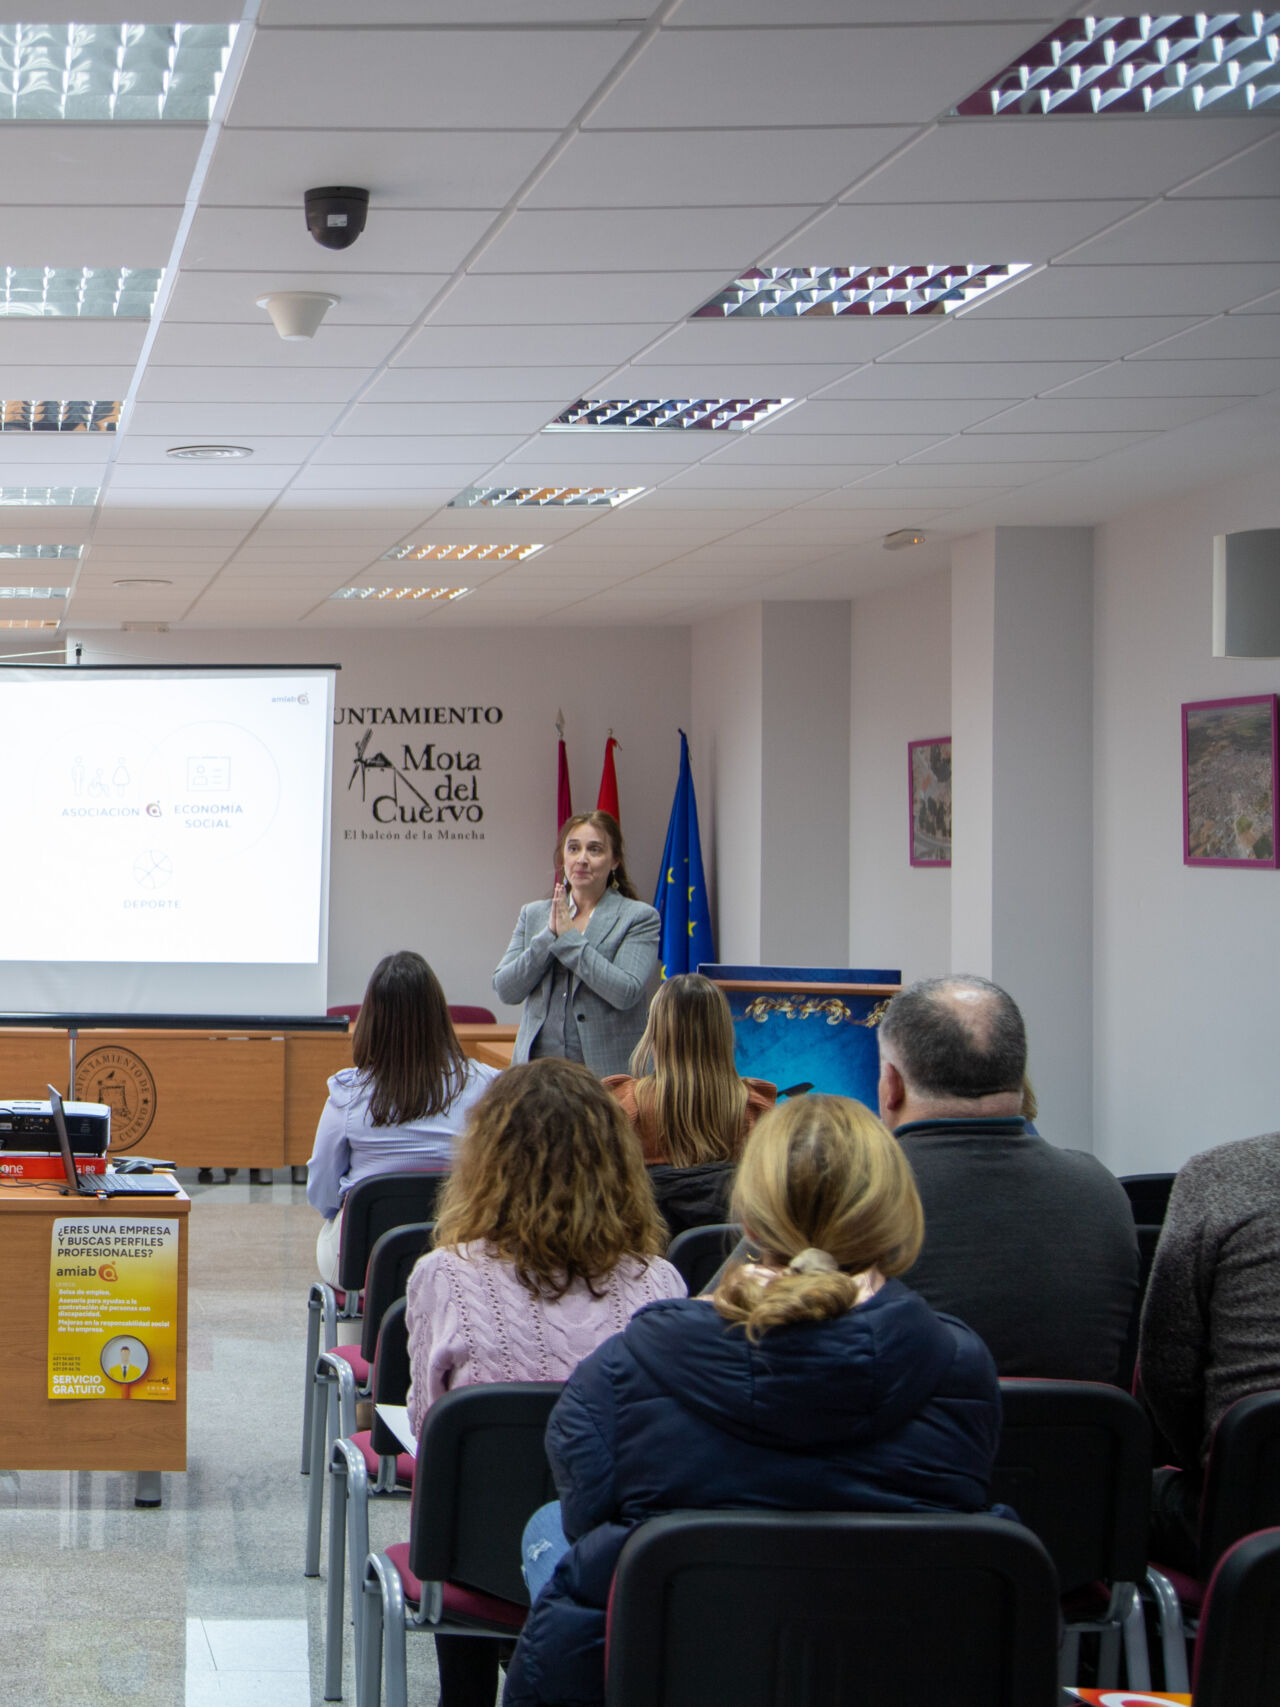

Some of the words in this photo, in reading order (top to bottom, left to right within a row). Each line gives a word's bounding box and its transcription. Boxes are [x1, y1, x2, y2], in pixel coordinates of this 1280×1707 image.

[334, 706, 504, 725] UNTAMIENTO
[401, 743, 482, 772] Mota
[434, 774, 480, 801] del
[372, 795, 484, 824] Cuervo
[184, 818, 232, 829] SOCIAL
[344, 829, 357, 840] El
[361, 829, 401, 840] balcón
[405, 829, 419, 840] de
[422, 829, 433, 840] la
[437, 829, 486, 840] Mancha
[123, 899, 181, 910] DEPORTE
[57, 1226, 90, 1237] ¿ERES
[92, 1225, 116, 1235] UNA
[119, 1226, 171, 1235] EMPRESA
[58, 1238, 64, 1246] Y
[67, 1237, 111, 1246] BUSCAS
[114, 1237, 164, 1247] PERFILES
[57, 1248, 154, 1258] PROFESIONALES?
[56, 1266, 97, 1277] amiab
[52, 1375, 101, 1384] SERVICIO
[52, 1385, 106, 1395] GRATUITO
